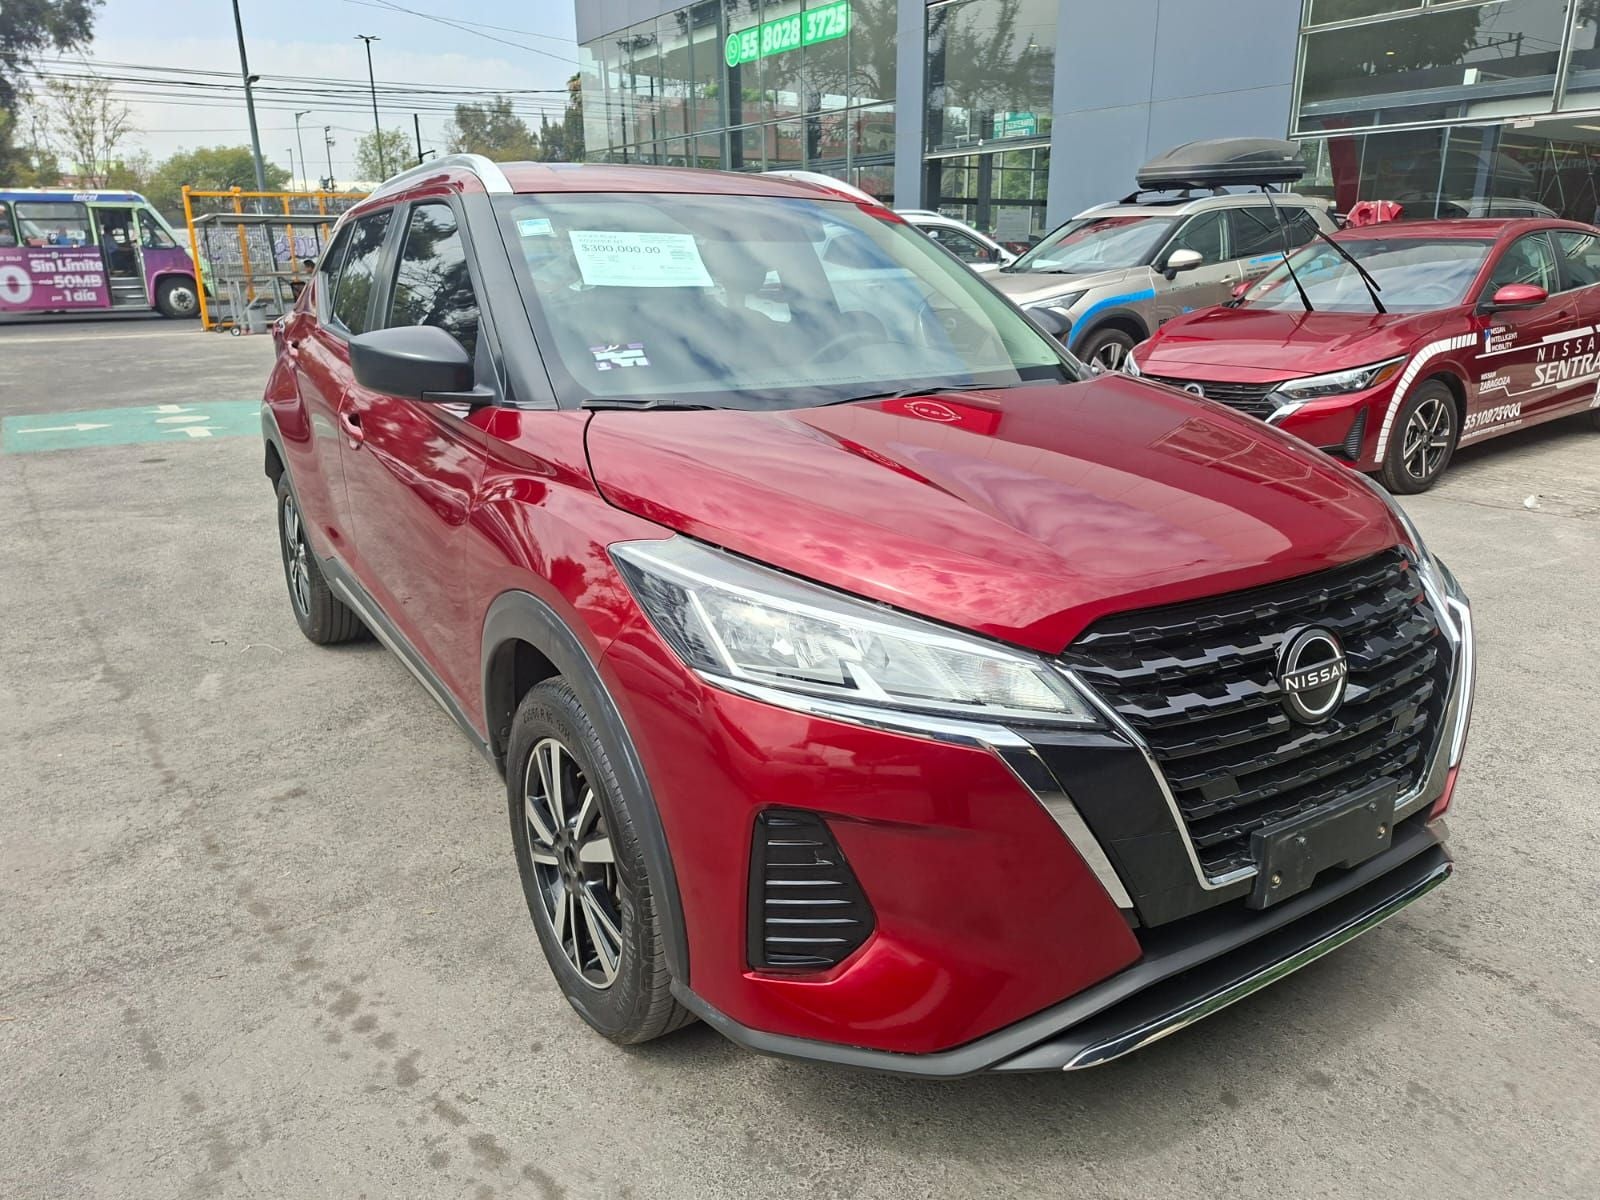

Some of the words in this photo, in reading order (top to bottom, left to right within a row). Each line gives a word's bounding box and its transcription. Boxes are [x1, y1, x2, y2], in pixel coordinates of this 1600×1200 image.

[740, 31, 758, 59] 55
[762, 18, 800, 53] 8028
[806, 3, 848, 41] 3725
[581, 243, 661, 255] $300,000.00
[30, 259, 56, 273] Sin
[56, 258, 104, 272] Límite
[54, 275, 102, 289] 50MB
[64, 290, 72, 302] 1
[73, 289, 97, 302] día
[1492, 342, 1513, 352] MOBILITY
[1531, 351, 1600, 388] SENTRA
[1480, 376, 1511, 391] ZARAGOZA
[1285, 659, 1348, 691] NISSAN
